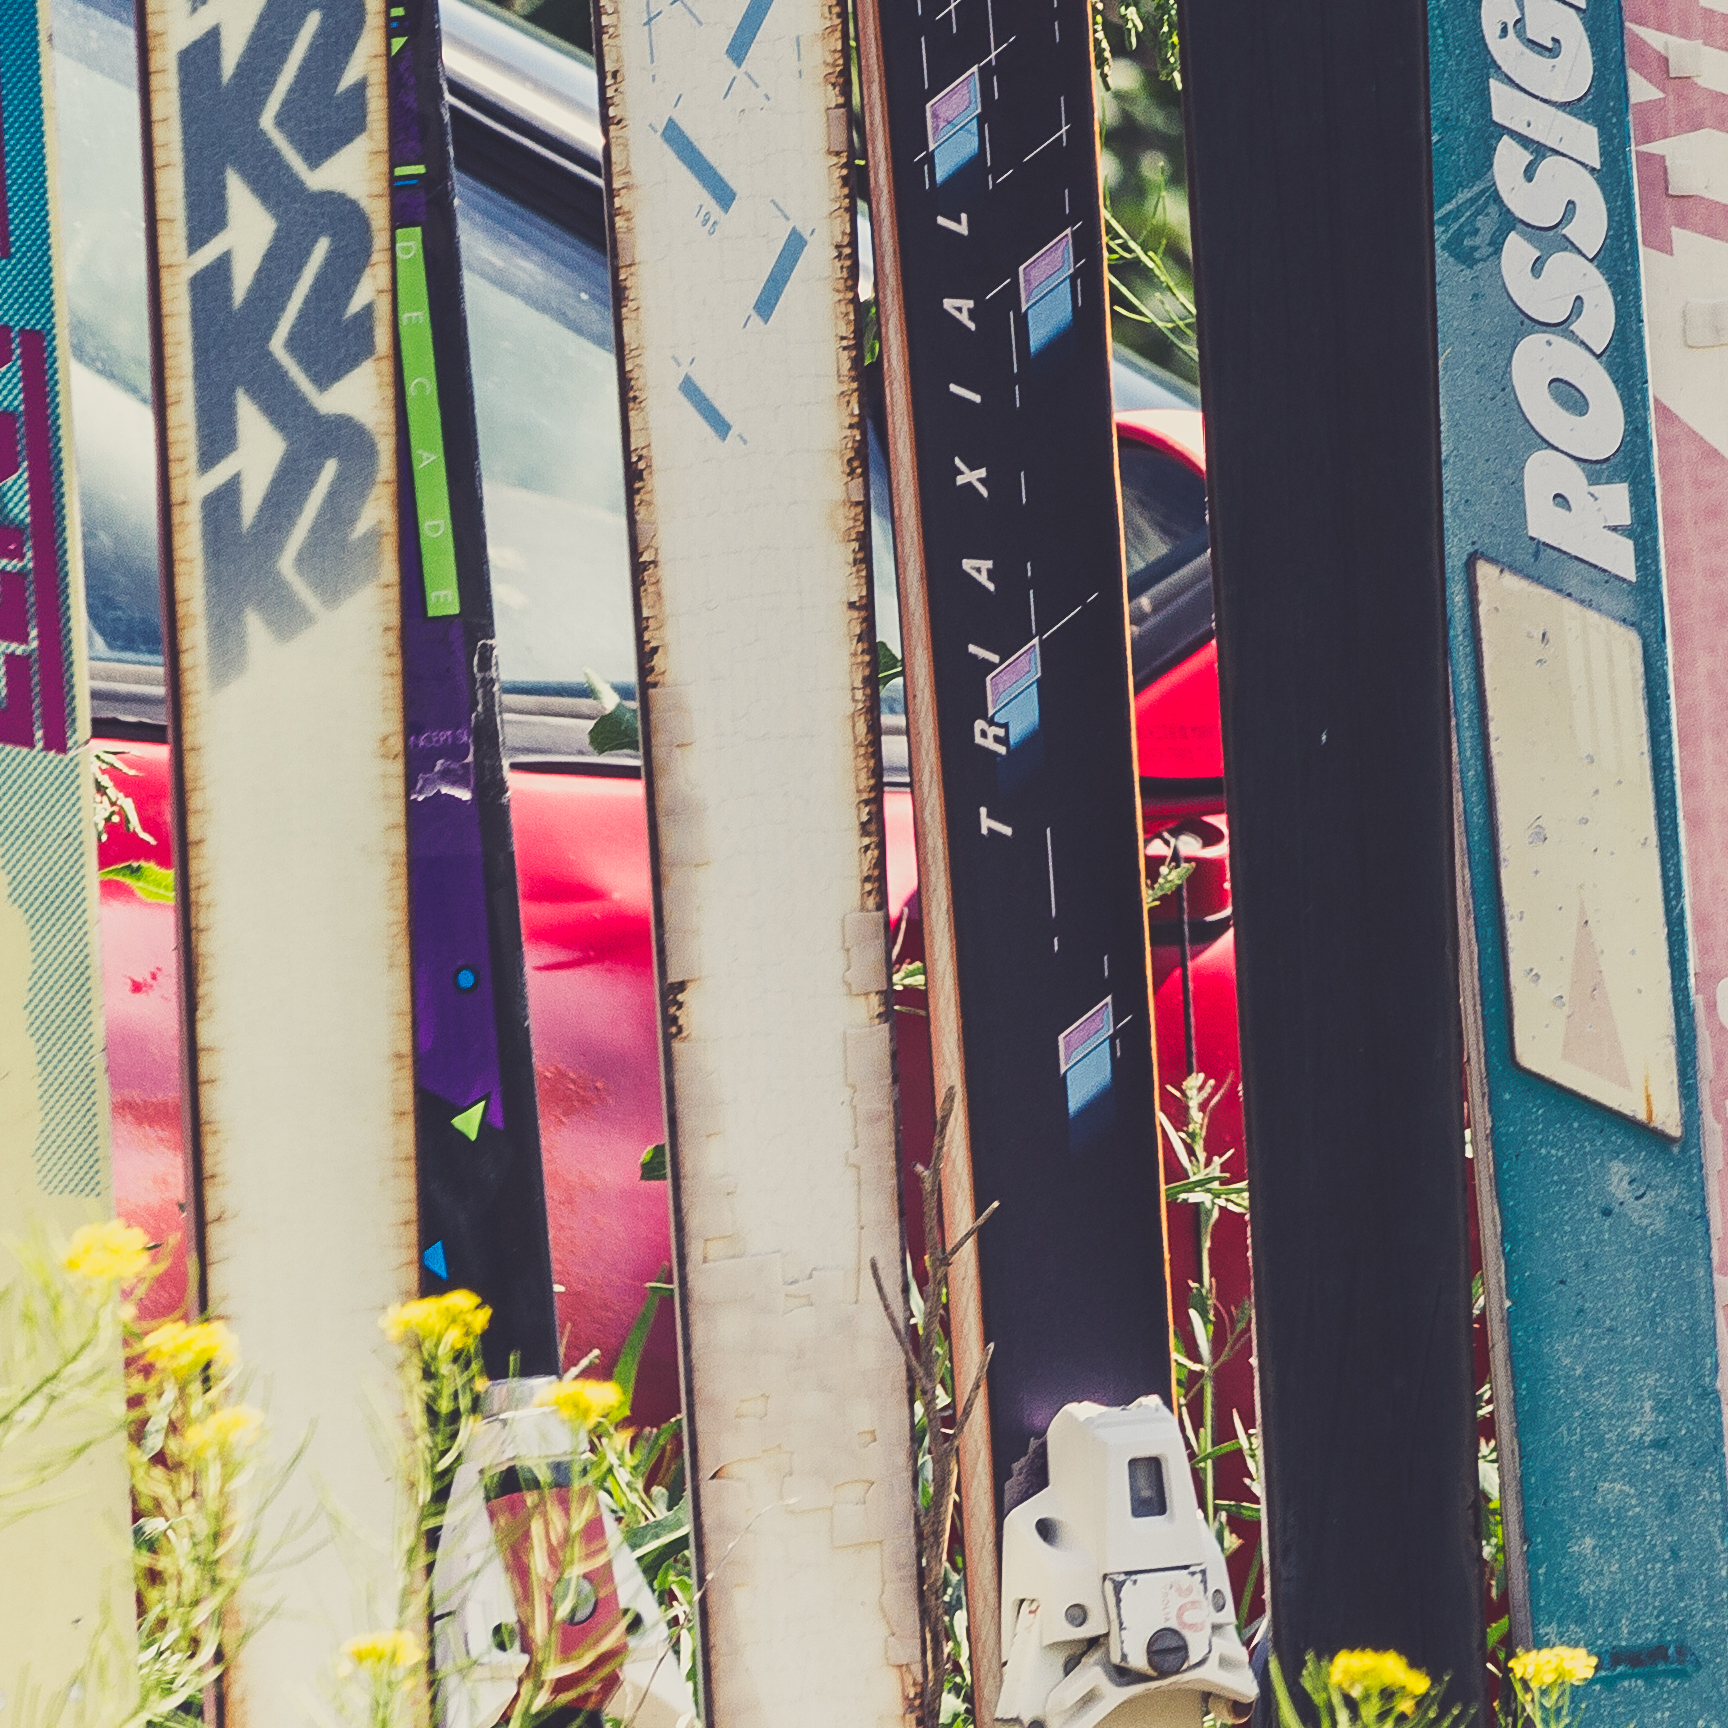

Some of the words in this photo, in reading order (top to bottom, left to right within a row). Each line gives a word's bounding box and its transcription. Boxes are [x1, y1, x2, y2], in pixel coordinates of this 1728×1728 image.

[186, 187, 376, 475] K2
[397, 238, 455, 608] DECADE
[198, 412, 383, 696] K2
[936, 209, 1017, 842] TRIAXIAL
